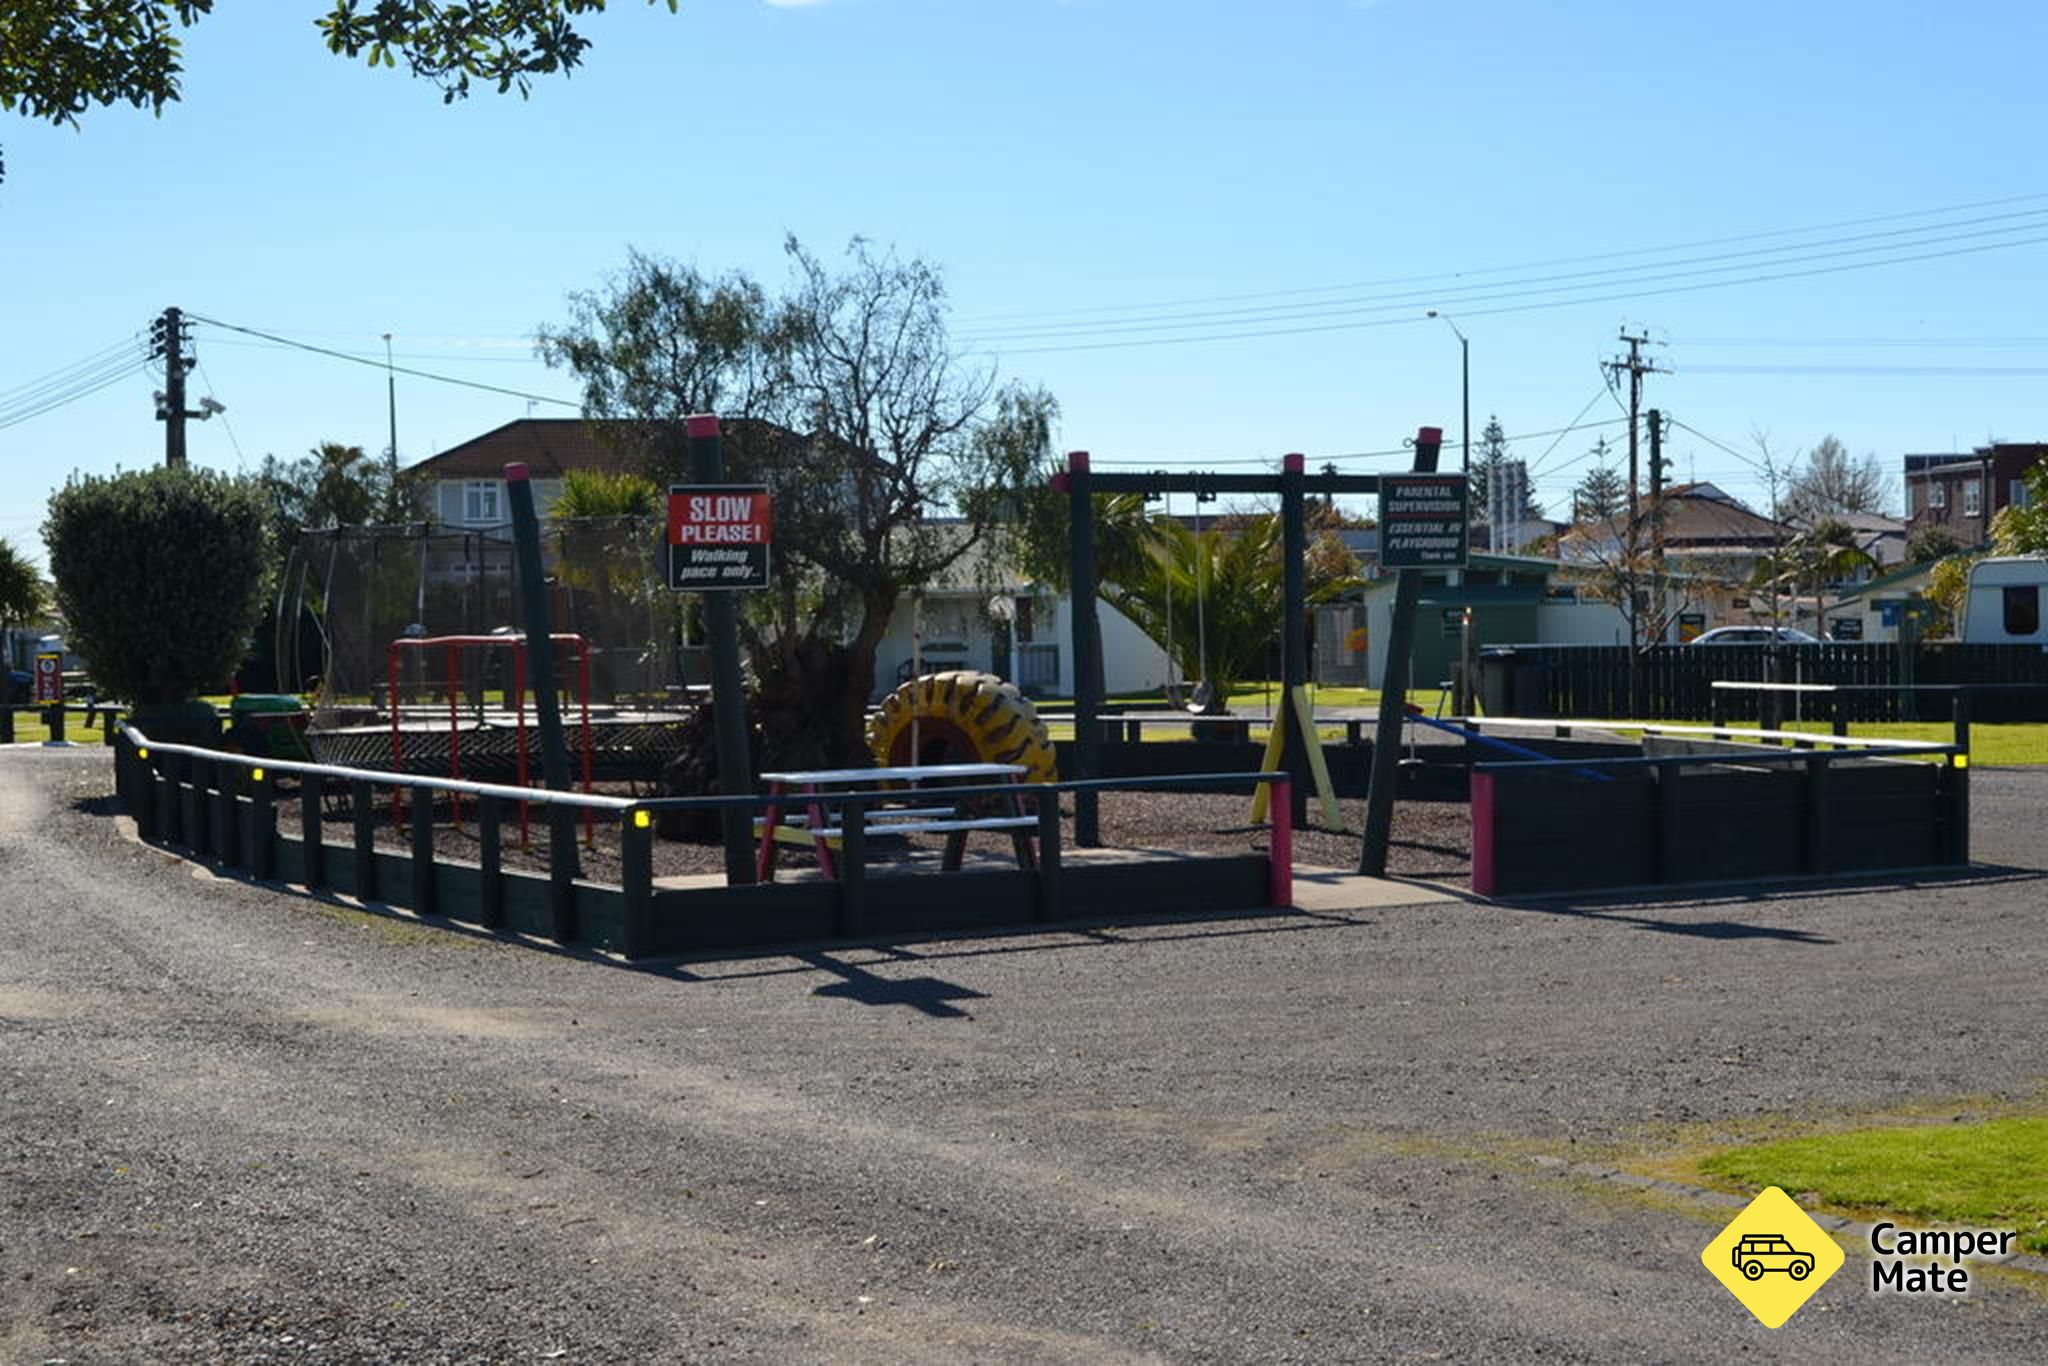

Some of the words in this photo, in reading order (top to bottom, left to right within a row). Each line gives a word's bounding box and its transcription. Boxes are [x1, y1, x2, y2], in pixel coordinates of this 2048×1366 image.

[689, 496, 752, 523] SLOW
[691, 549, 749, 563] Walking
[680, 566, 717, 580] pace
